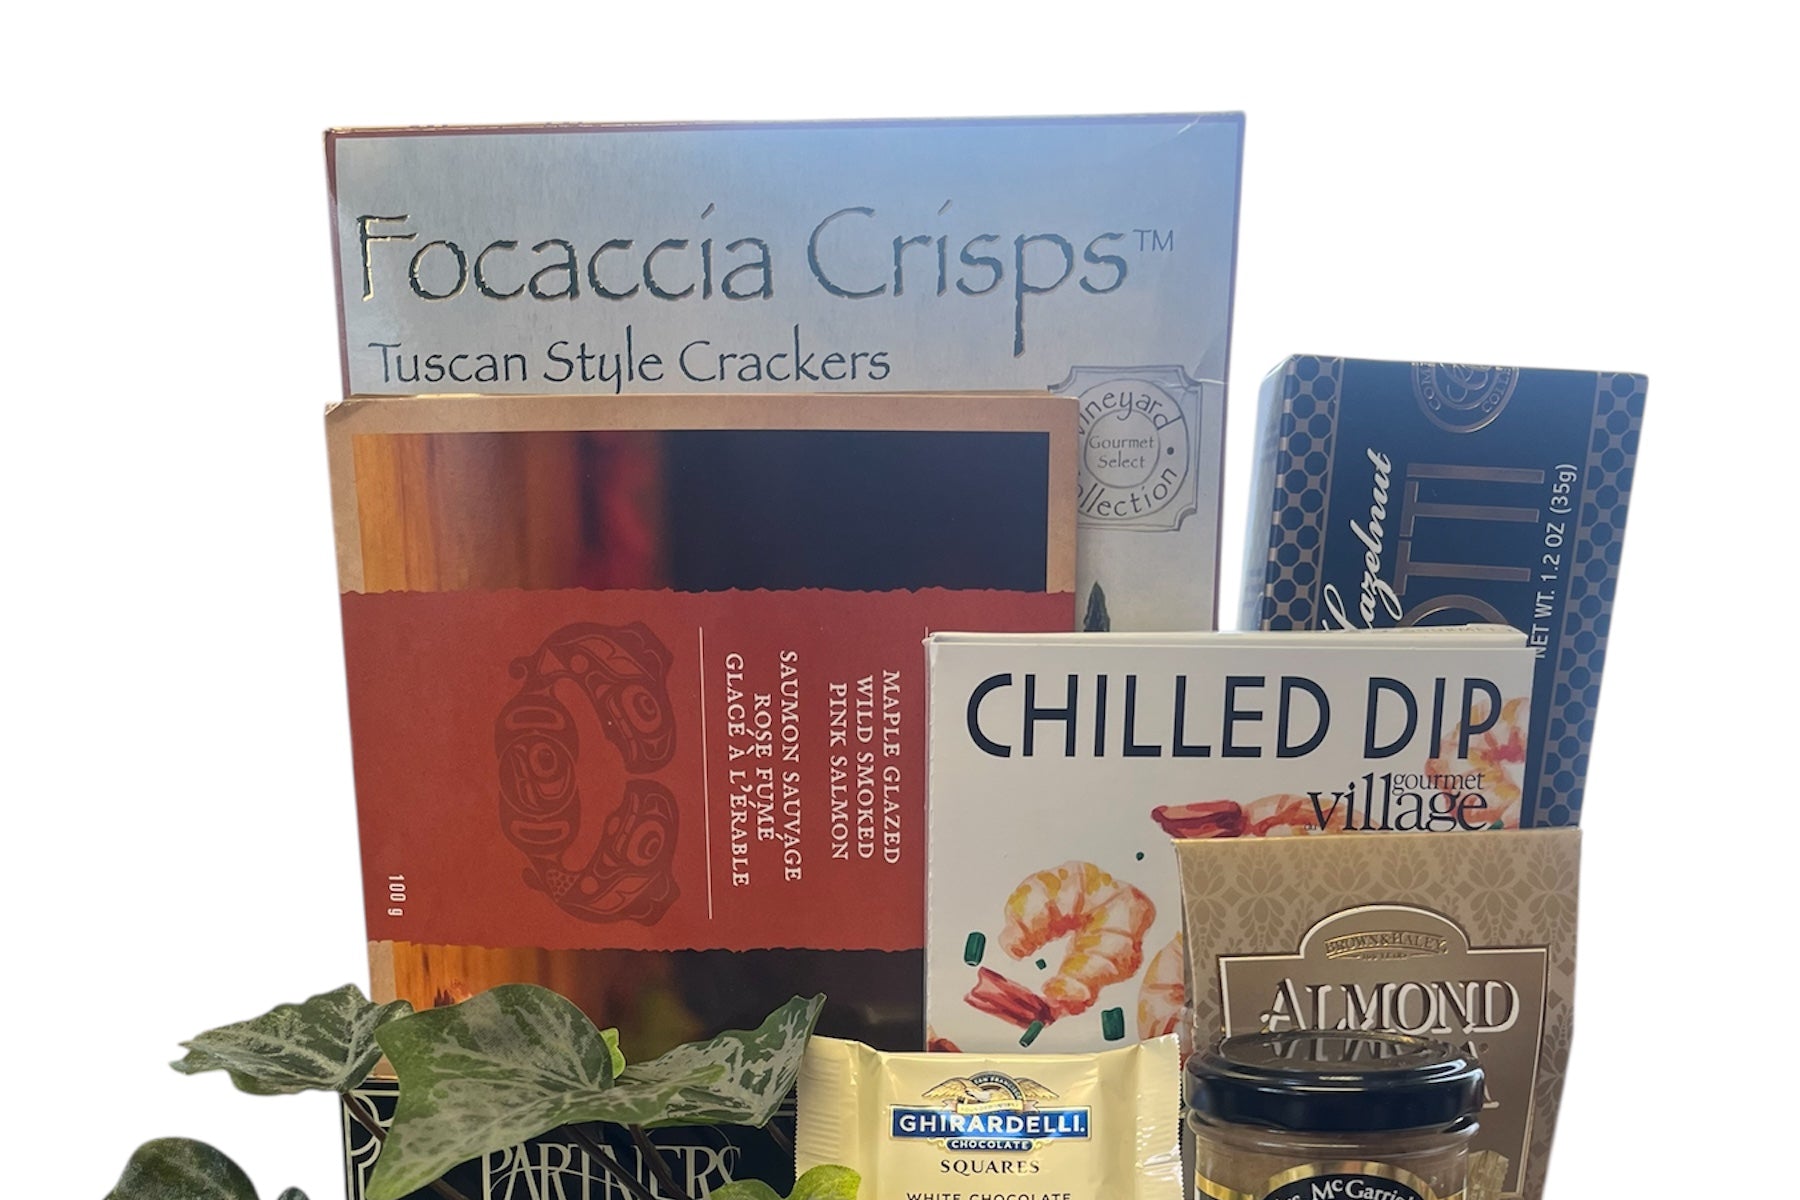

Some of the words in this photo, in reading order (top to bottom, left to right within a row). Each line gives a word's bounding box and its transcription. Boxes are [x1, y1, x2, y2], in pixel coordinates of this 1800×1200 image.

[356, 203, 774, 301] Focaccia
[807, 199, 1128, 358] Crisps
[368, 341, 527, 383] Tuscan
[543, 323, 664, 394] Style
[679, 323, 890, 383] Crackers
[1088, 436, 1155, 449] Gourmet
[1097, 451, 1146, 469] Select
[1550, 464, 1578, 514] (35g)
[1545, 522, 1565, 548] OZ
[1541, 553, 1561, 583] 1.2
[1535, 591, 1555, 619] WT.
[726, 653, 753, 737] GLACÉ
[754, 692, 772, 758] ROSE
[780, 650, 799, 762] SAUMON
[829, 682, 847, 747] PINK
[857, 675, 873, 743] WILD
[883, 669, 900, 757] MAPLE
[966, 672, 1331, 758] CHILLED
[1364, 677, 1502, 760] DIP
[728, 745, 754, 761] À
[756, 767, 784, 841] FUMÉ
[829, 755, 848, 860] SALMON
[857, 751, 875, 859] SMOKED
[883, 766, 901, 864] GLAZED
[1308, 773, 1488, 832] village
[1393, 772, 1484, 797] gourmet
[783, 771, 801, 881] SAUVAGE
[388, 873, 406, 904] 100
[388, 907, 403, 917] g
[1259, 978, 1520, 1034] ALMOND
[940, 1159, 1040, 1176] SQUARES
[951, 1139, 1029, 1150] CHOCOLATE
